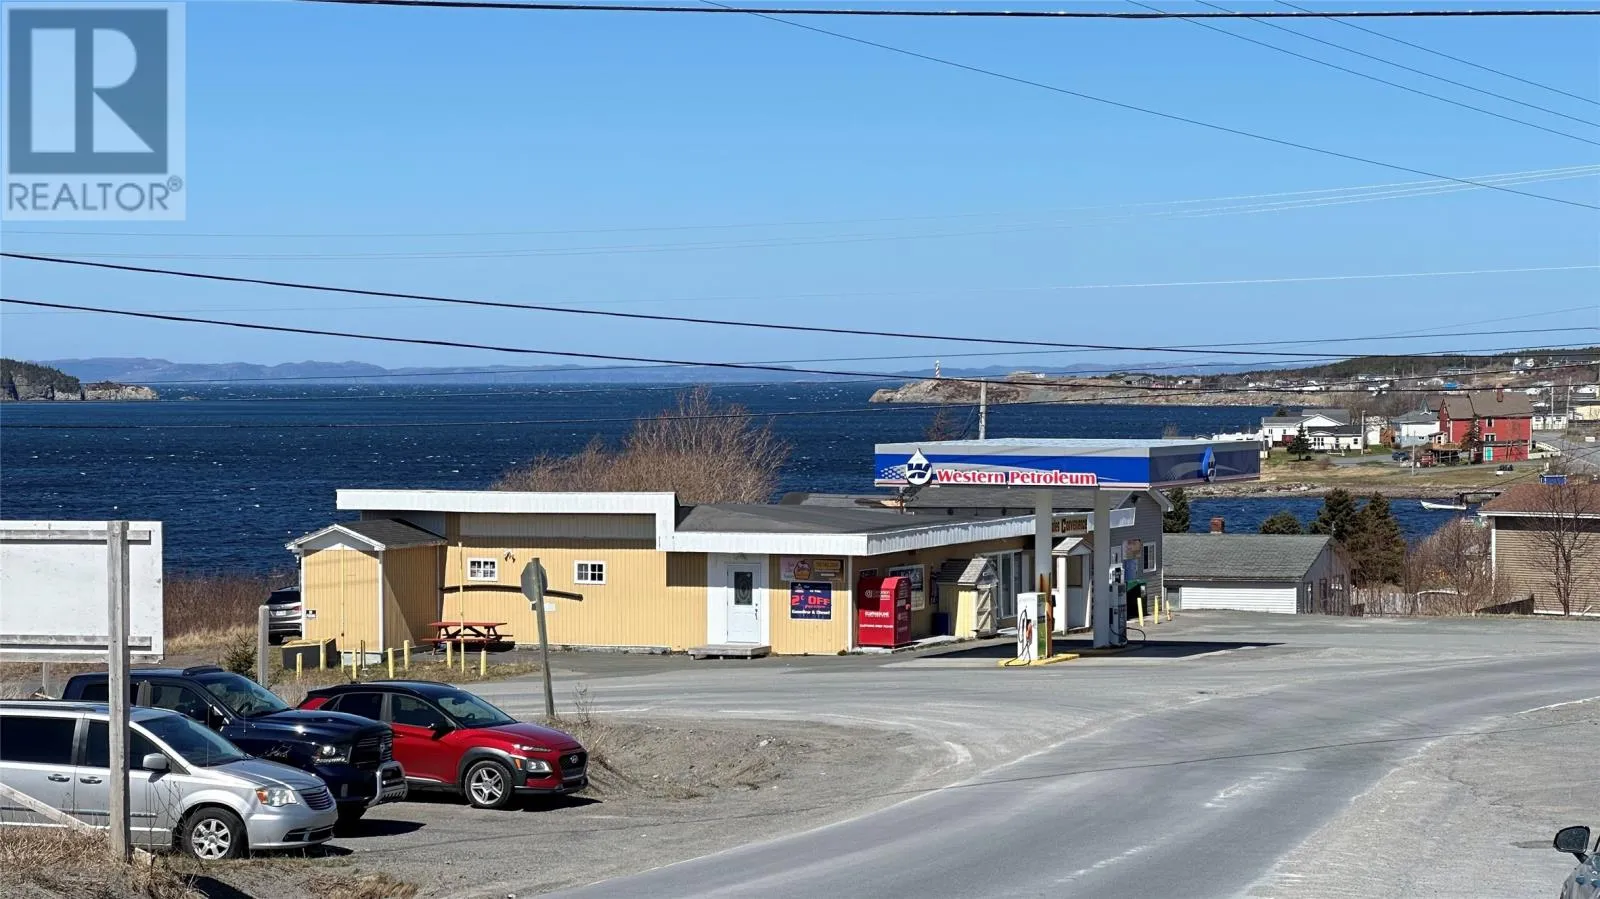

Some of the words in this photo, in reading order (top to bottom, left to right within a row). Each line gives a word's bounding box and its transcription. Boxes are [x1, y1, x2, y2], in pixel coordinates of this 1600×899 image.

[937, 470, 1005, 484] Western
[1010, 470, 1096, 485] Petroleum
[807, 595, 831, 606] OFF
